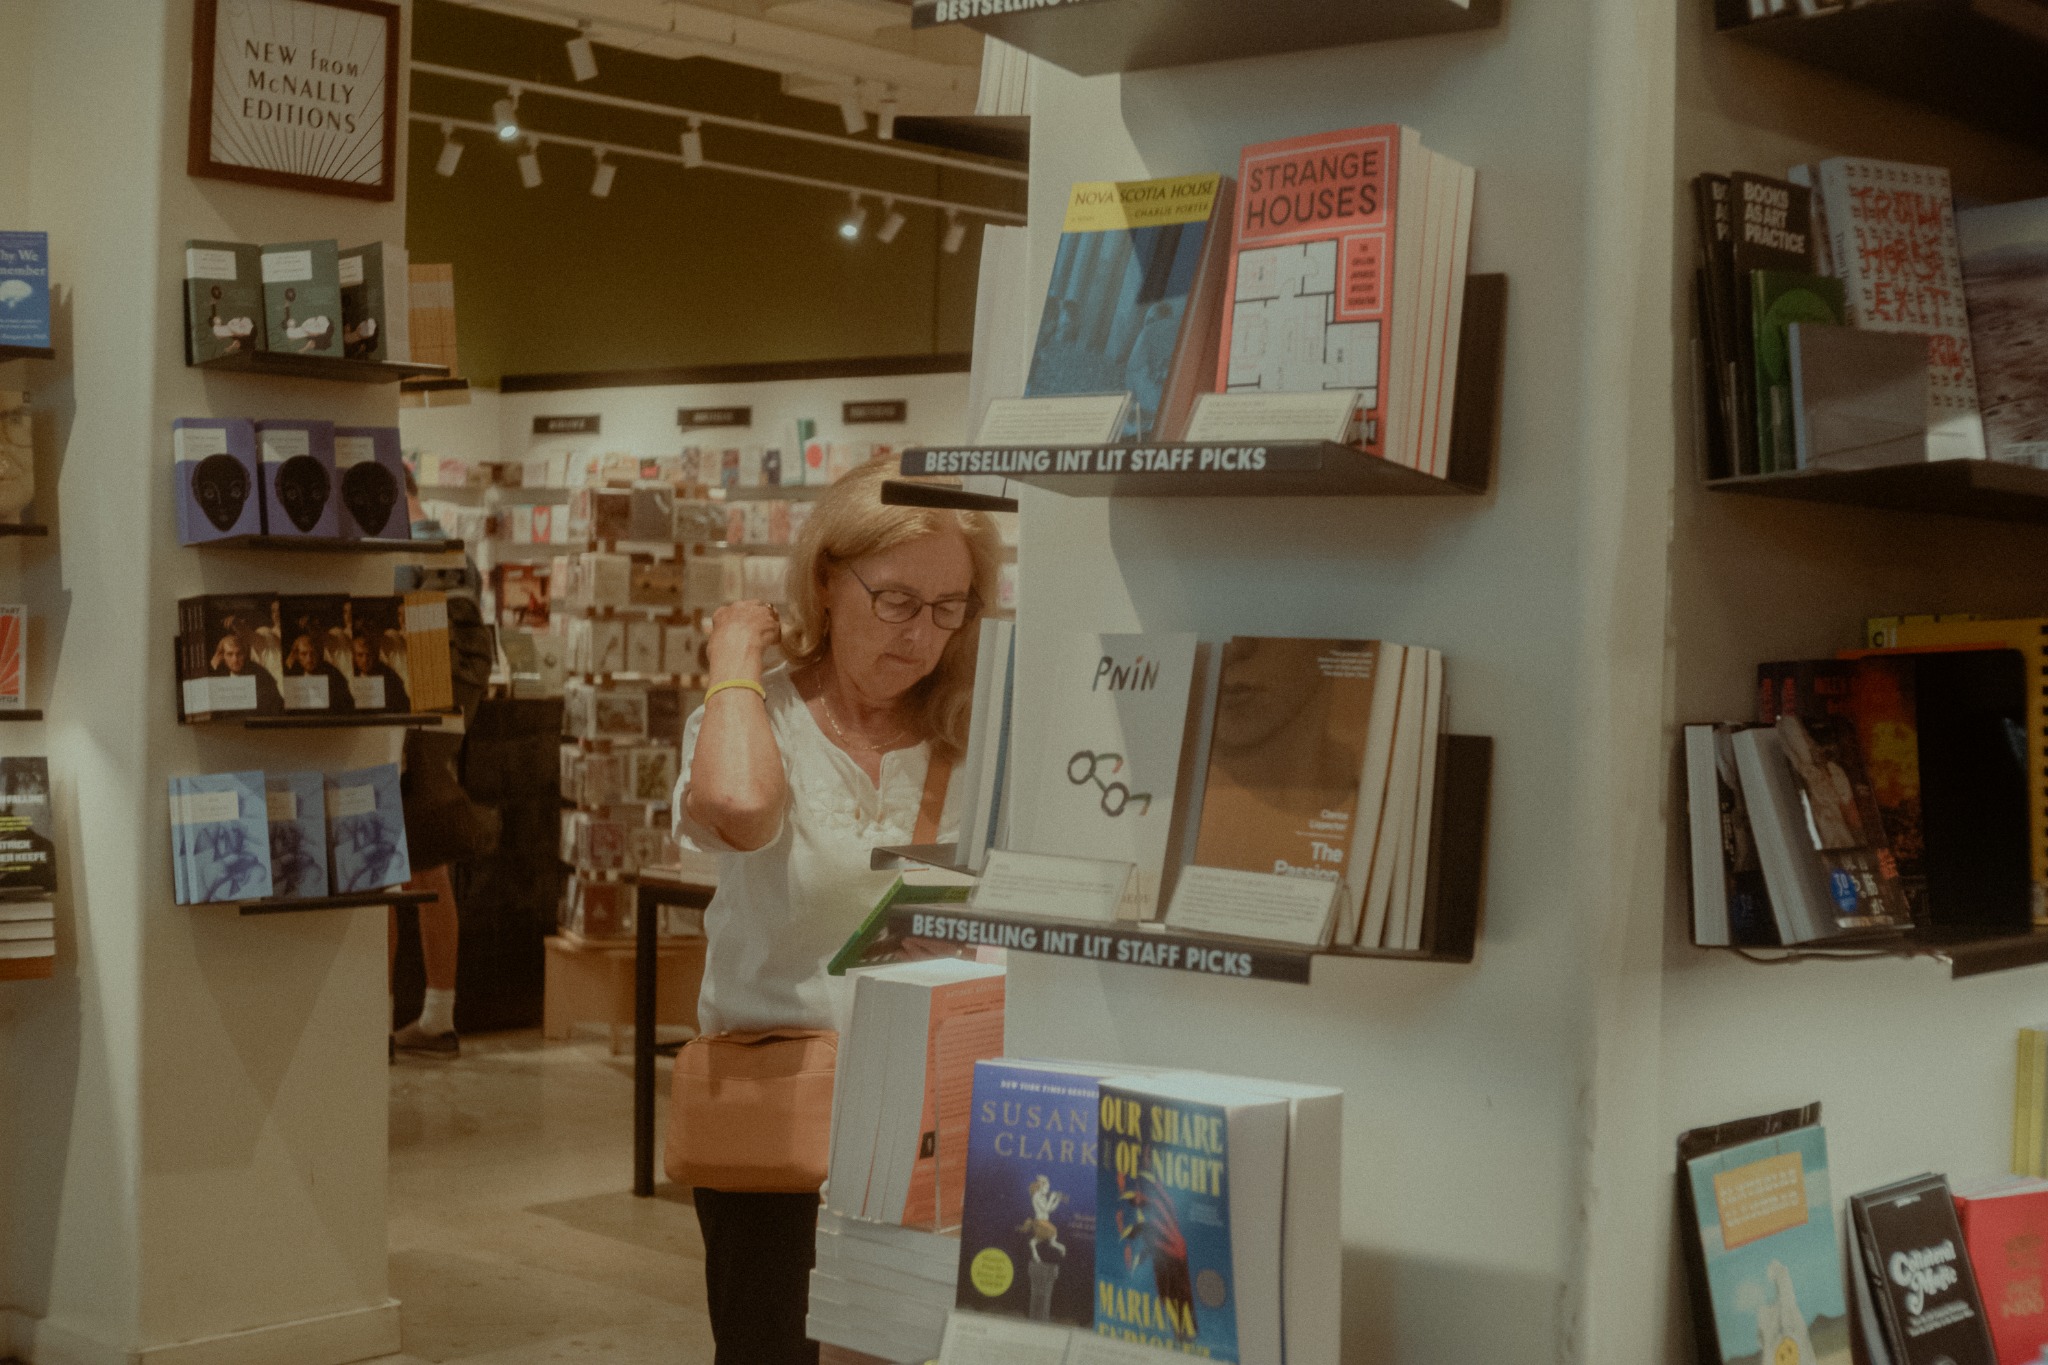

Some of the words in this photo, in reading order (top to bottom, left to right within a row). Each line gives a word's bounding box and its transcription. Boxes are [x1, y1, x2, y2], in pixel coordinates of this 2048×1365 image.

[936, 0, 1060, 22] BESTSELL
[244, 38, 297, 66] NEW
[248, 68, 354, 105] McNALLY
[242, 97, 356, 134] EDITIONS
[1249, 149, 1378, 193] STRANGE
[1074, 191, 1115, 205] NOVA
[1119, 186, 1166, 203] SCOTIA
[1170, 180, 1215, 199] HOUSE
[1246, 182, 1378, 231] HOUSES
[1743, 181, 1789, 210] BOOKS
[1134, 206, 1172, 218] CHARLIE
[1175, 203, 1208, 214] PORTER
[1745, 202, 1762, 223] AS
[1763, 206, 1787, 229] ART
[1744, 222, 1805, 254] PRACTICE
[18, 249, 39, 262] We
[1874, 282, 1950, 328] EXIT
[925, 450, 1050, 472] BESTSELLING
[1056, 450, 1092, 471] INT
[1096, 449, 1126, 471] LIT
[1131, 449, 1193, 472] STAFF
[1199, 447, 1267, 471] PICKS
[1311, 841, 1343, 863] The
[912, 914, 1037, 949] BESTSELLING
[1043, 930, 1078, 955] INT
[1083, 937, 1111, 960] LIT
[1117, 939, 1180, 968] STAFF
[1186, 948, 1252, 977] PICKS
[1020, 1082, 1041, 1093] YORK
[1042, 1084, 1066, 1096] TIMES
[981, 1100, 1090, 1134] SUSAN
[1101, 1095, 1141, 1142] OUR
[1151, 1106, 1223, 1154] SHARE
[1116, 1141, 1140, 1179] OF
[1152, 1148, 1223, 1197] NIGHT
[1098, 1279, 1197, 1338] MARIANA
